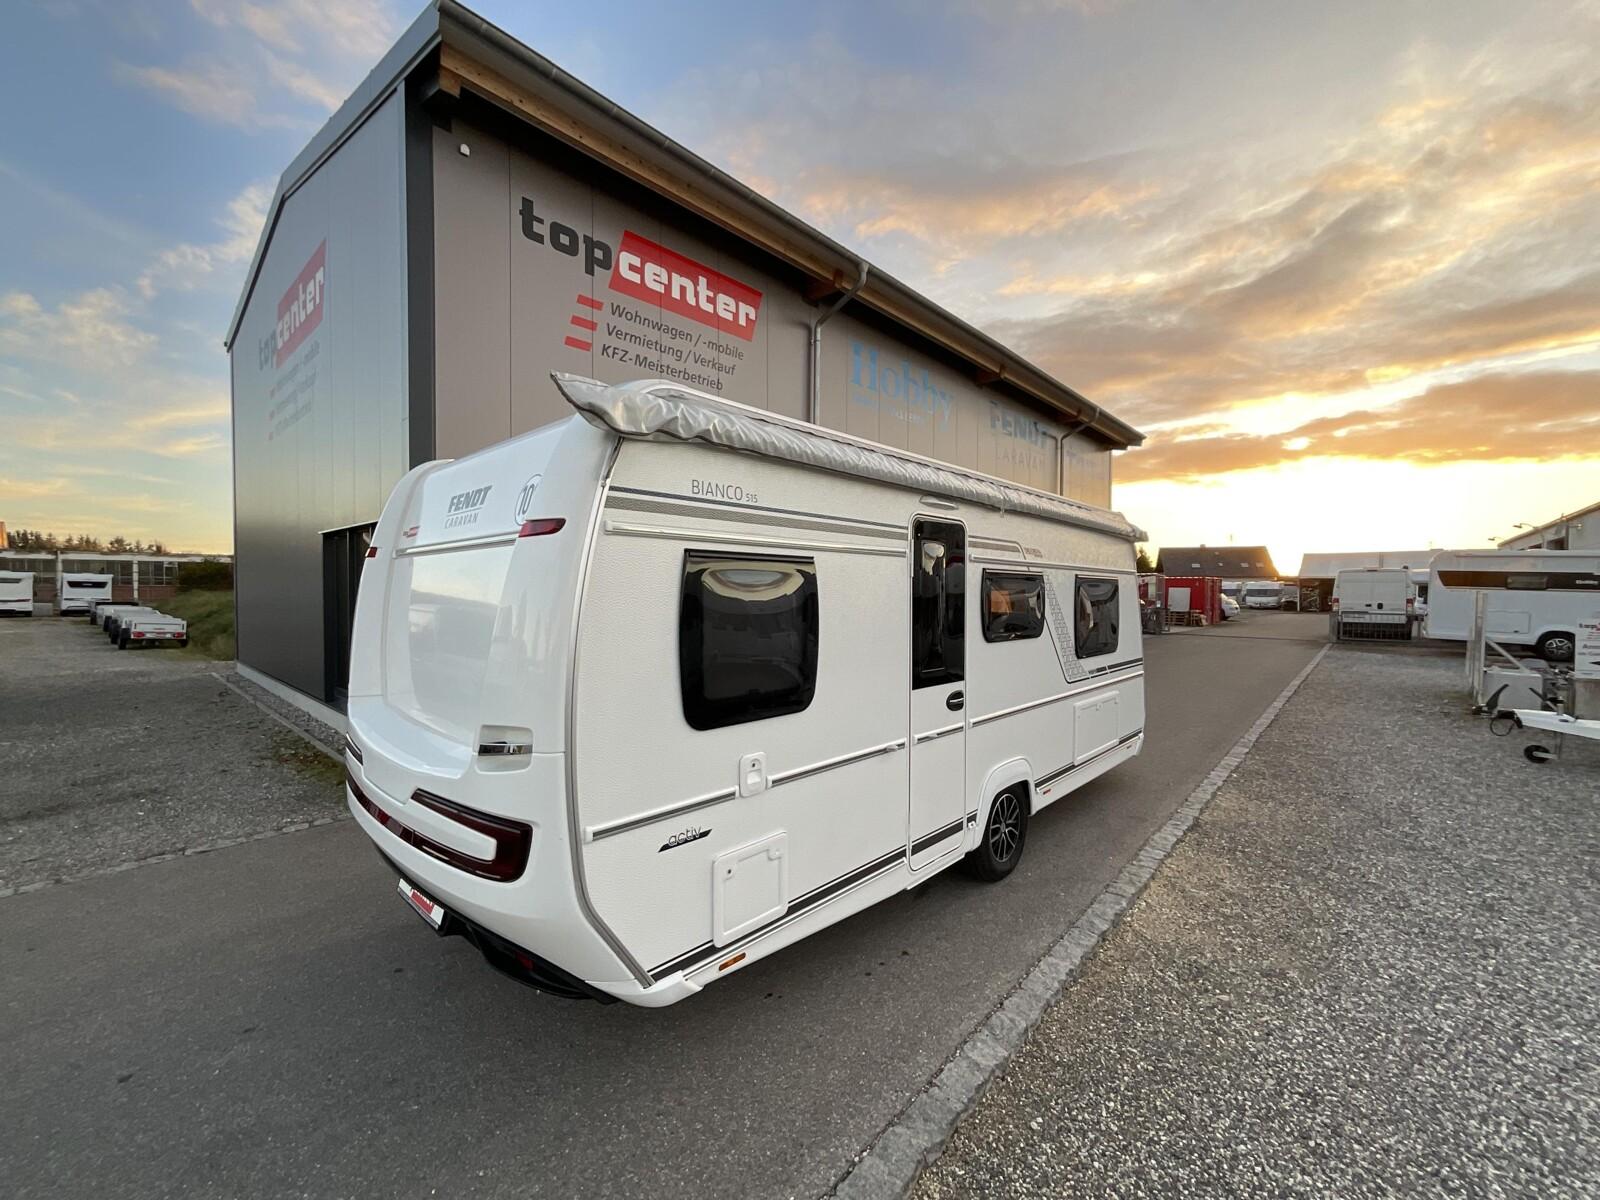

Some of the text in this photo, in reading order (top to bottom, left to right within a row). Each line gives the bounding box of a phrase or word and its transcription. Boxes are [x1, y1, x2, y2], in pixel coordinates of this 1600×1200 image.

[610, 302, 693, 342] Wohnwagen
[606, 322, 683, 362] Vermietung
[693, 351, 737, 376] Verkauf
[601, 343, 724, 391] KFZ-Meisterbetrieb
[852, 341, 953, 431] Hobby
[448, 485, 493, 514] FENDT
[517, 483, 535, 516] 10
[691, 479, 758, 503] BIANCO 515
[444, 512, 480, 530] CARAVAN
[668, 825, 702, 846] activ
